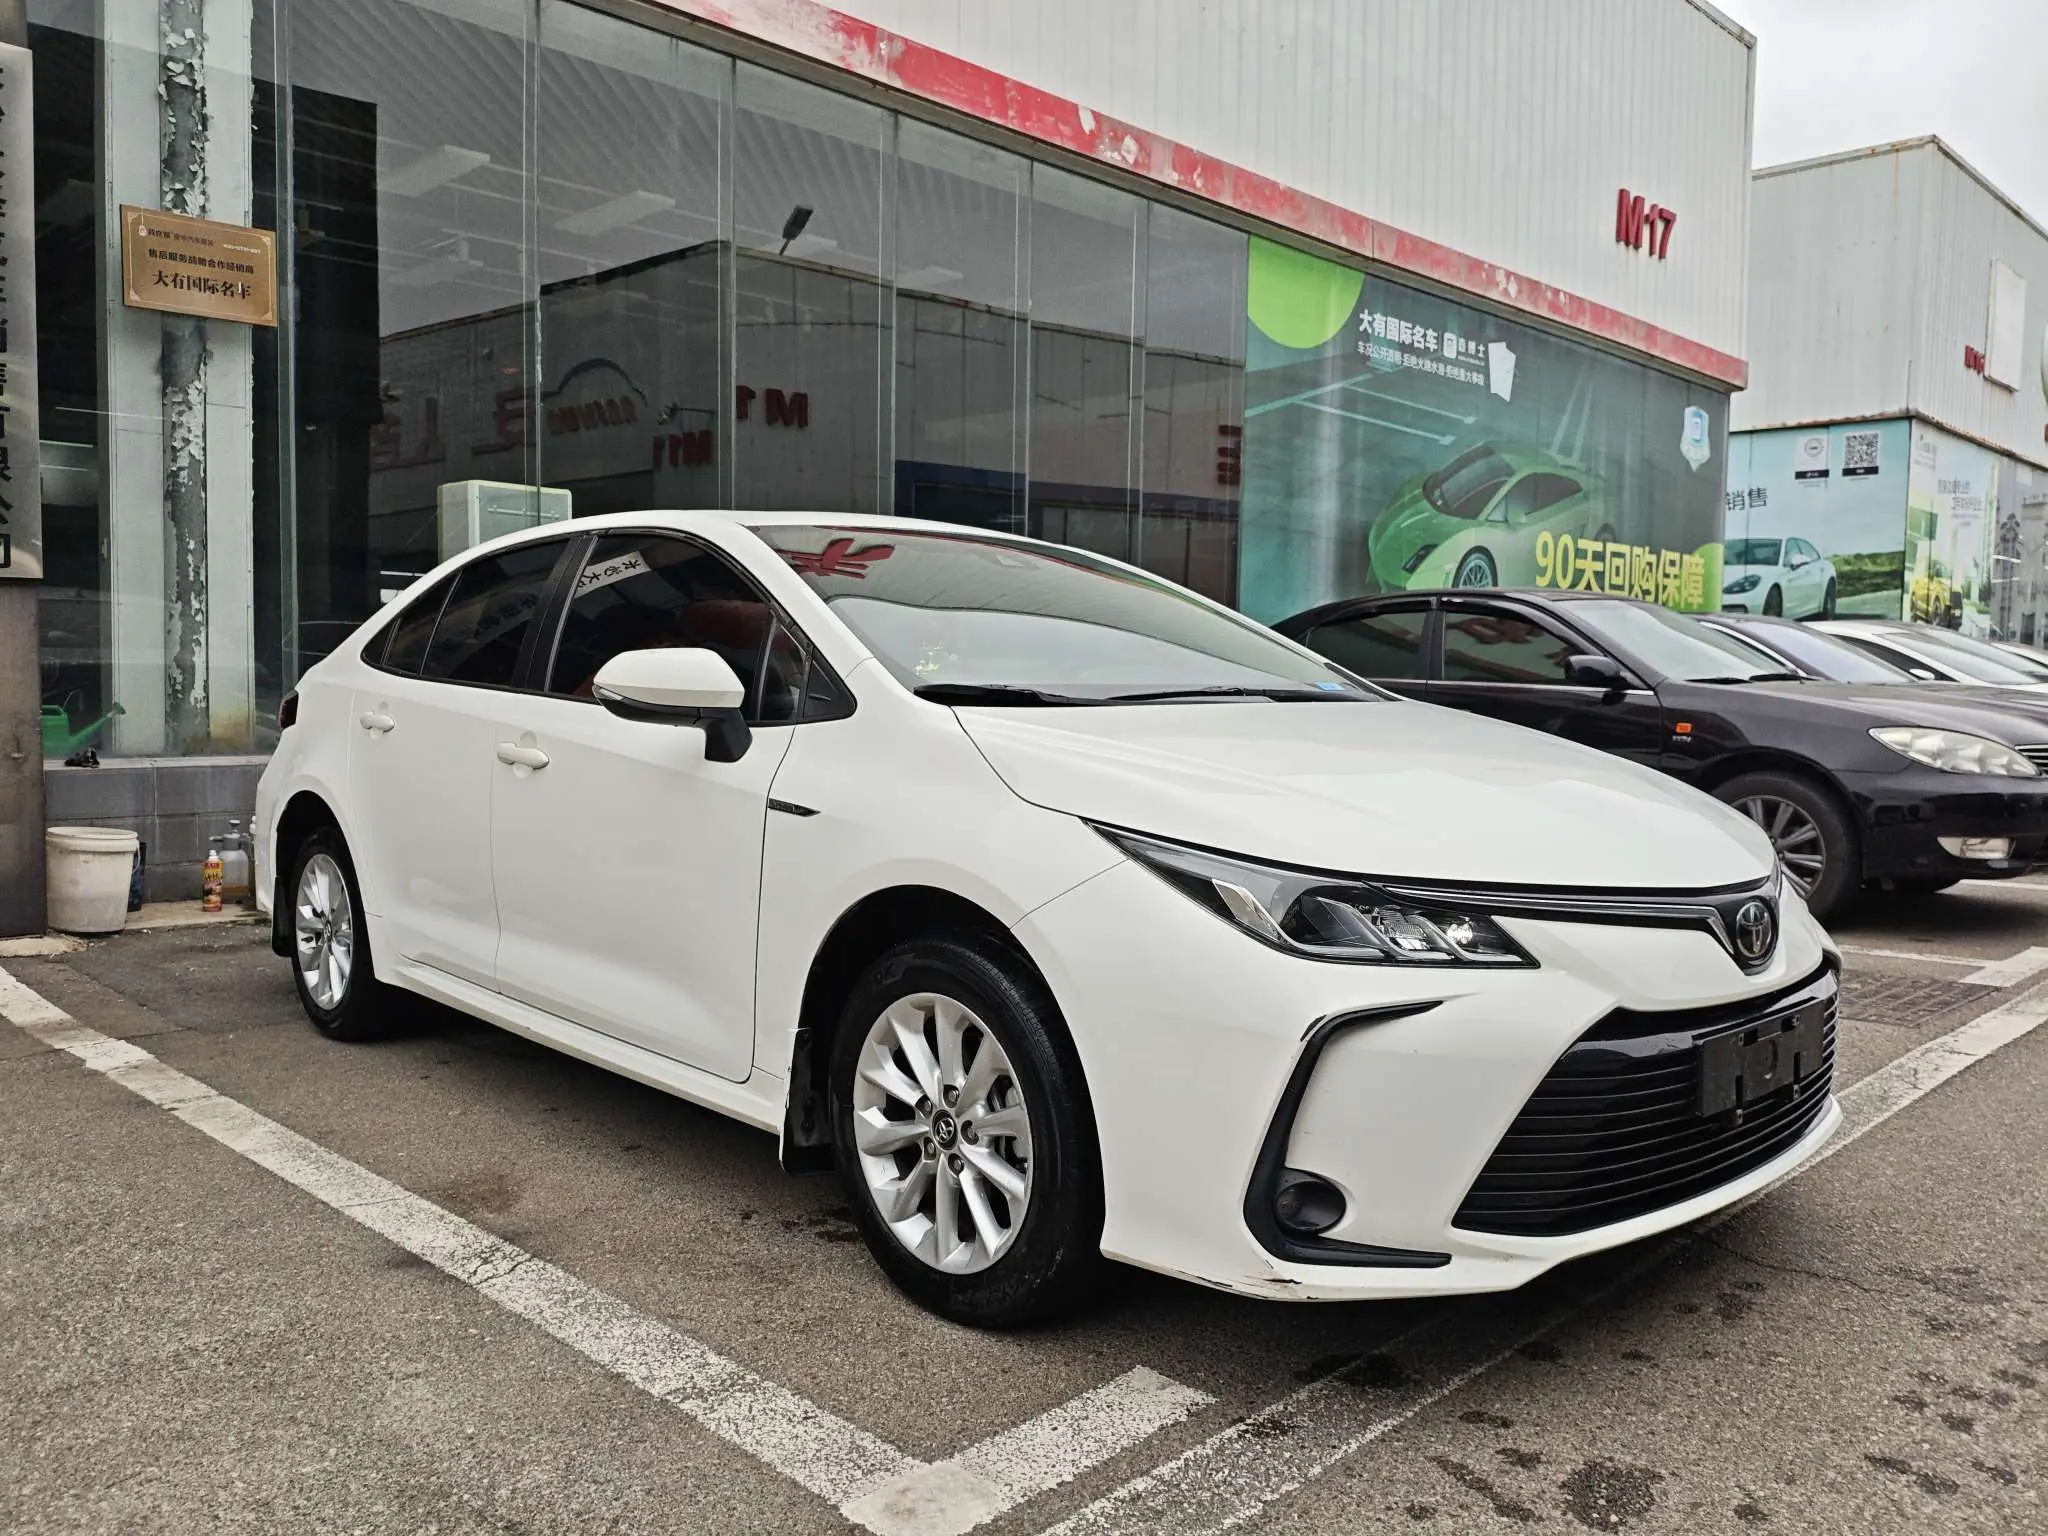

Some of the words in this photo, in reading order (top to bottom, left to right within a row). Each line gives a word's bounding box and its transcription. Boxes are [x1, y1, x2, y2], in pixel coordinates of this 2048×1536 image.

[1616, 188, 1676, 261] M17
[152, 269, 252, 300] 大有国际名车
[1358, 308, 1439, 352] 大有国际名车
[1535, 530, 1704, 609] 90天回购保障
